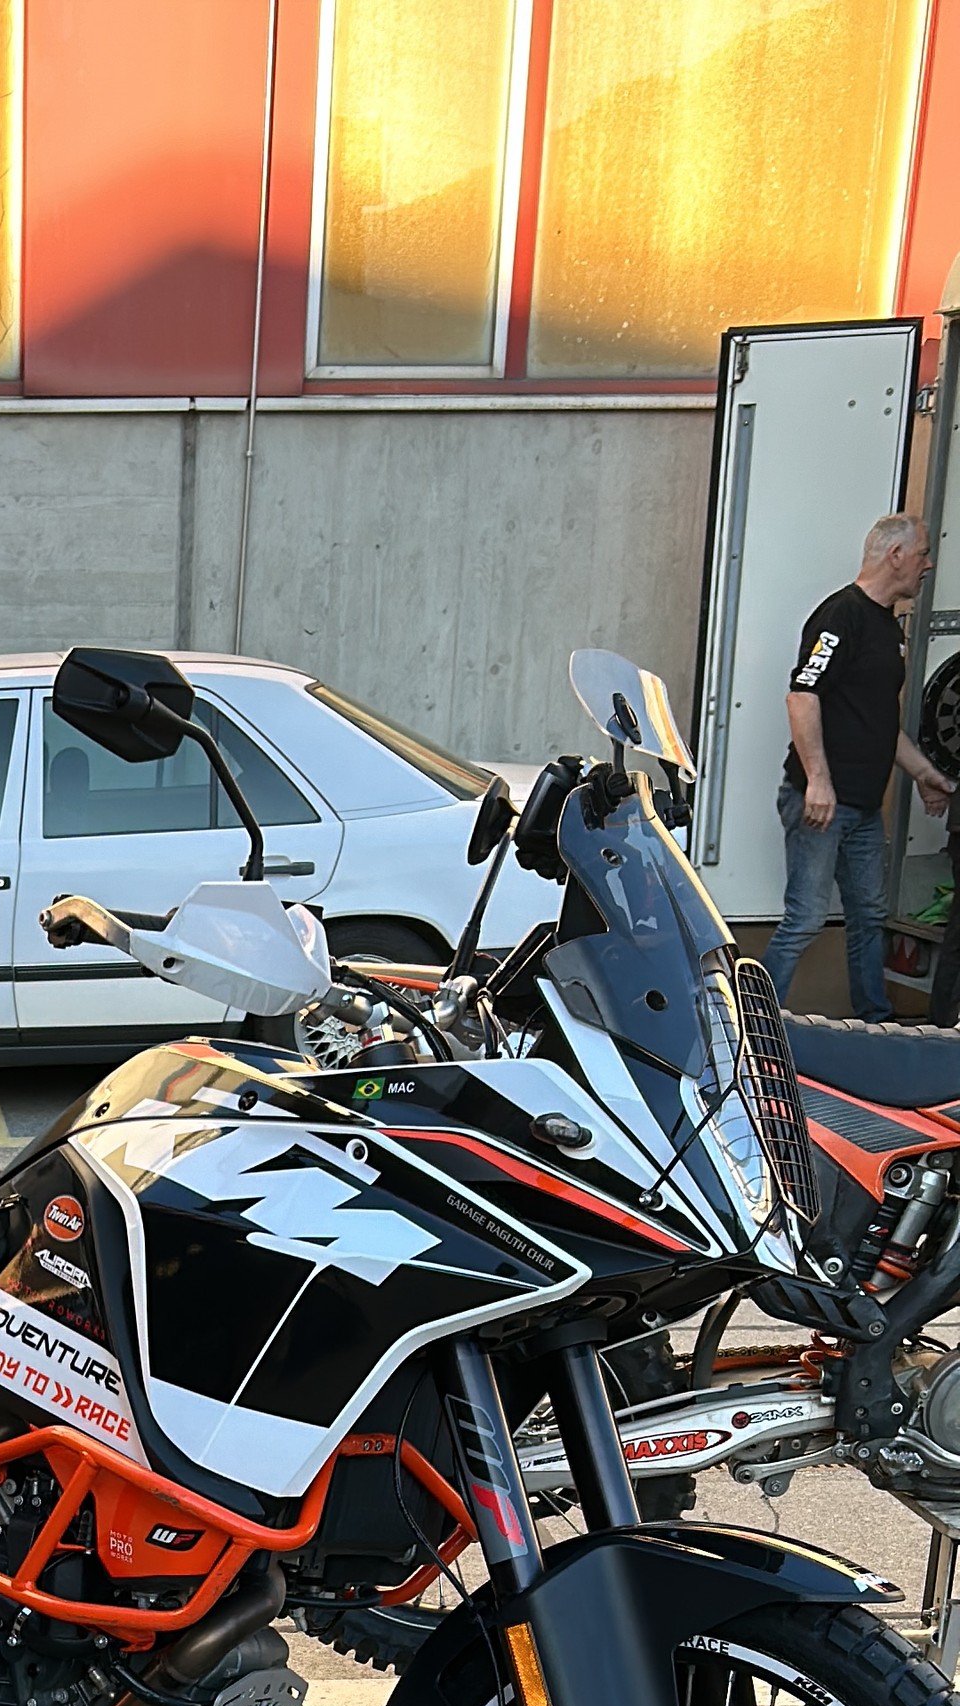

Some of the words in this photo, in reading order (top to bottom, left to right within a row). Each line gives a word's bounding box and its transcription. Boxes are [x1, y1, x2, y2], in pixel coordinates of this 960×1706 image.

[387, 1081, 415, 1094] MAC
[48, 1204, 70, 1226] Twin
[65, 1213, 83, 1232] Air
[446, 1194, 486, 1227] GARAGE
[486, 1219, 526, 1253] RAGUTH
[526, 1247, 556, 1272] CHUR
[34, 1249, 93, 1288] AURORA
[20, 1366, 51, 1396] TO
[74, 1394, 132, 1442] RACE
[749, 1404, 804, 1424] 24MX
[623, 1431, 710, 1462] MAXXIS
[109, 1536, 133, 1556] PRO
[683, 1636, 730, 1656] RACE
[792, 1676, 834, 1706] KTM
